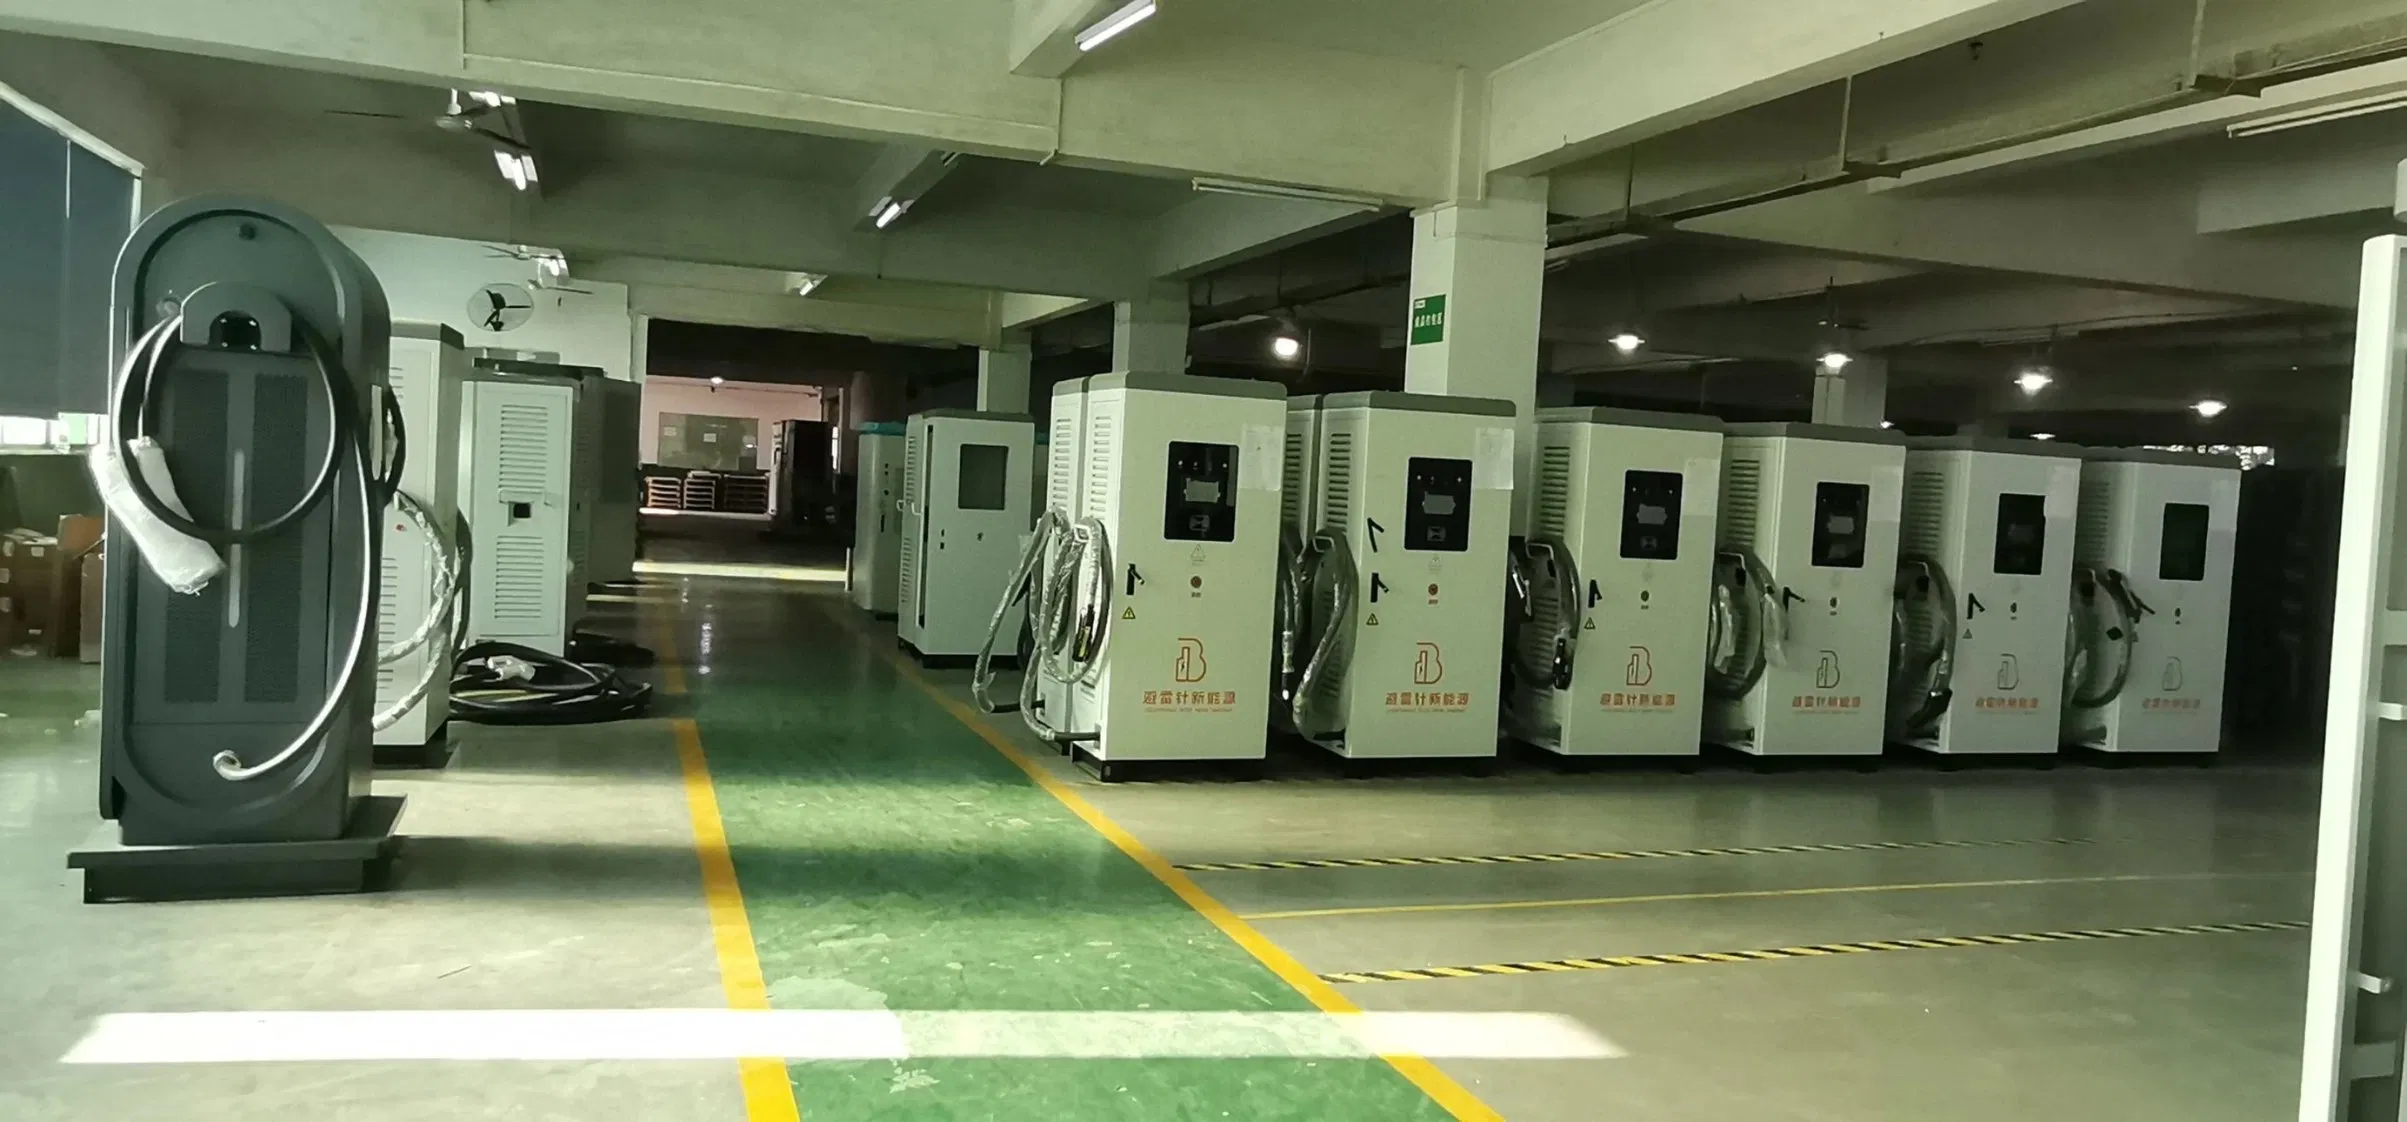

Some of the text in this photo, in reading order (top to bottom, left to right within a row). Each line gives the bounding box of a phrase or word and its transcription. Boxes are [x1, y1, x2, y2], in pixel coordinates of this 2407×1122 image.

[1143, 690, 1236, 705] 避雷针新能源
